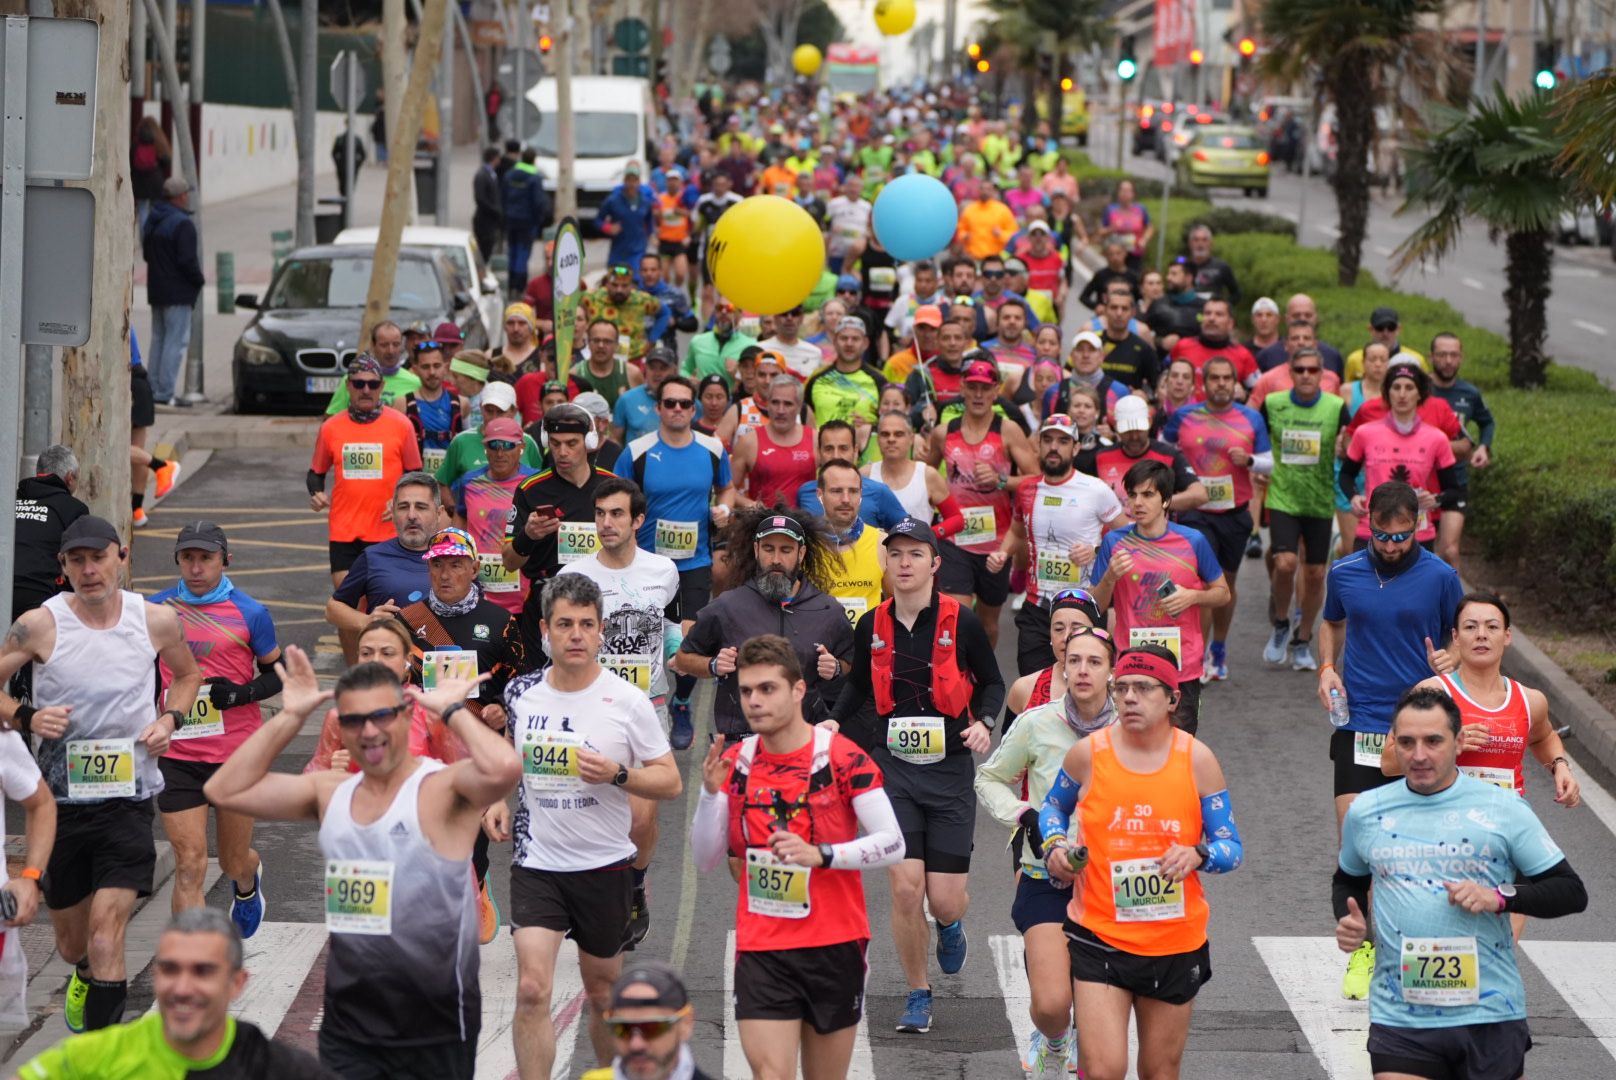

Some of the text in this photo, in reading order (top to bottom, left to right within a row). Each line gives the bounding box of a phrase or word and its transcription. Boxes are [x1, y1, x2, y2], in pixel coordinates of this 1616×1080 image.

[350, 452, 374, 465] 860
[567, 533, 595, 548] 926
[660, 530, 693, 545] 1010
[484, 564, 507, 577] 977
[1045, 561, 1071, 577] 852
[526, 715, 549, 730] XIX
[898, 730, 930, 748] 991
[532, 746, 569, 767] 944
[80, 754, 120, 775] 797
[532, 766, 569, 776] DOMINGO
[82, 775, 119, 783] RUSSELL
[1134, 804, 1152, 817] 30
[1372, 843, 1475, 861] CORRIENDO
[758, 868, 794, 892] 857
[1121, 875, 1175, 898] 1002
[338, 880, 375, 905] 969
[1132, 896, 1166, 907] MURCIA
[1417, 956, 1462, 979] 723
[1412, 979, 1467, 989] MATIASRPN
